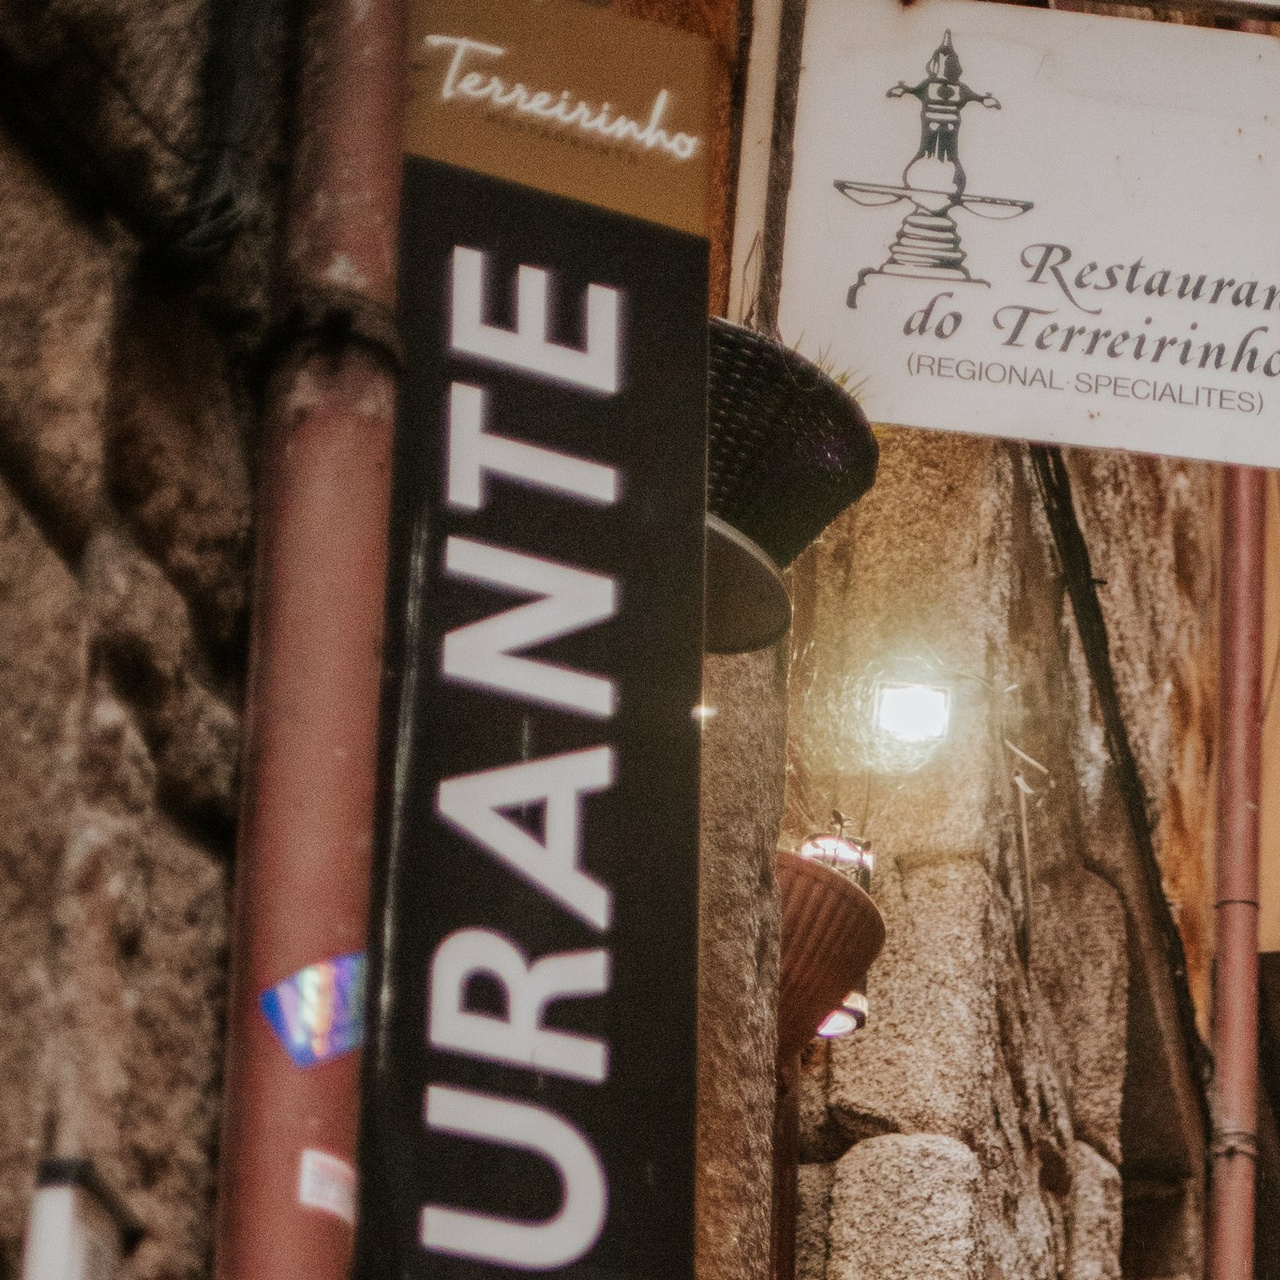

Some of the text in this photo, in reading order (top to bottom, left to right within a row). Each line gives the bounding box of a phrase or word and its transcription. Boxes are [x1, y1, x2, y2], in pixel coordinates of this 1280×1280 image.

[424, 34, 701, 160] Terreirinho
[903, 291, 962, 339] do
[906, 351, 1265, 415] (REGIONAL SPECIALITES)
